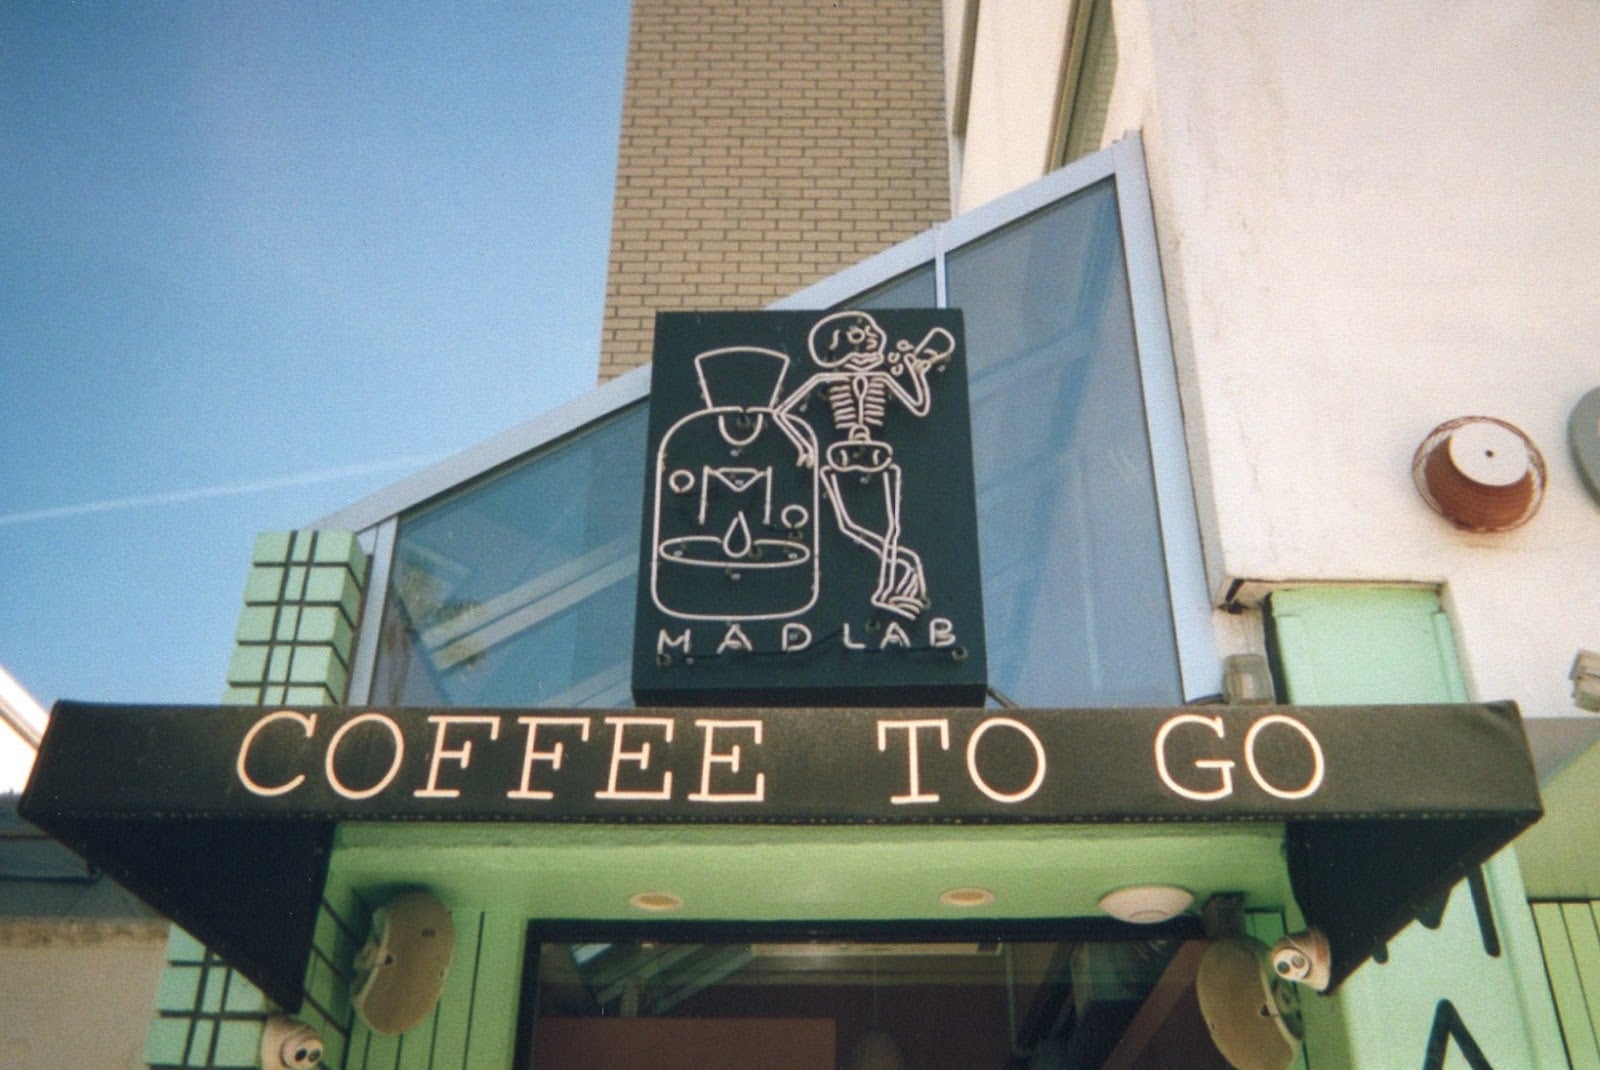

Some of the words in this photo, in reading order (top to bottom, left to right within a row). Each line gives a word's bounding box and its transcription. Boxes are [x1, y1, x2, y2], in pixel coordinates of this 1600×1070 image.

[656, 623, 812, 655] MAD
[842, 617, 956, 650] LAB
[236, 710, 765, 803] COFFEE
[876, 716, 1047, 805] TO
[1154, 714, 1325, 802] GO
